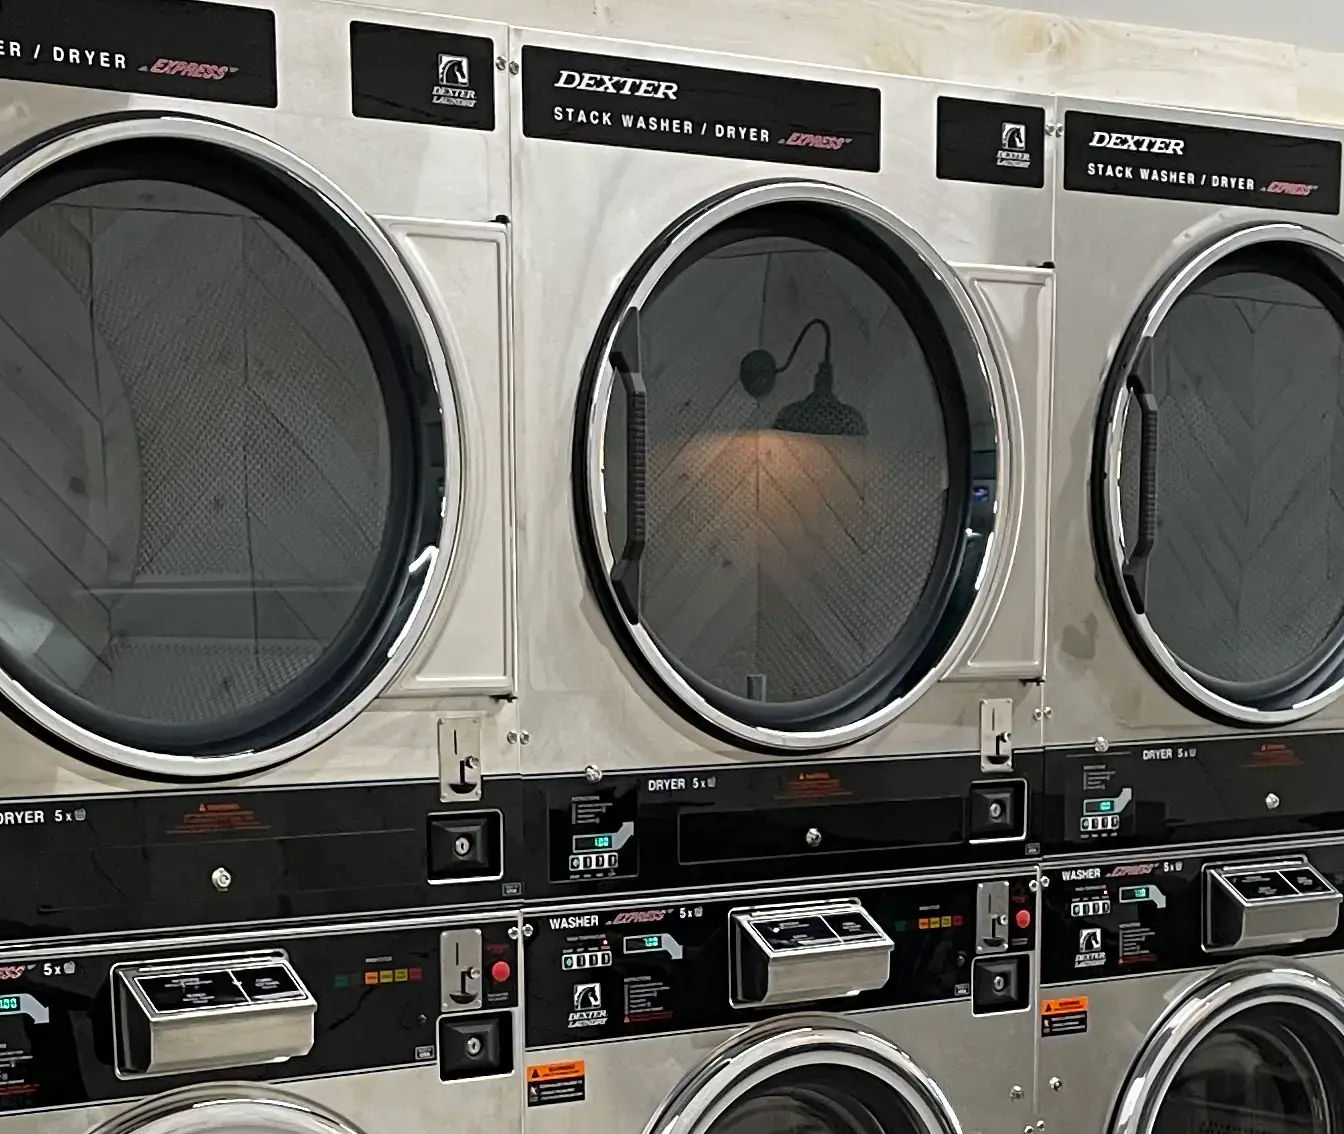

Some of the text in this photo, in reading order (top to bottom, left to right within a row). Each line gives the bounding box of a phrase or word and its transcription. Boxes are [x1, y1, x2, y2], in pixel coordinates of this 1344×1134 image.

[34, 44, 41, 58] /
[53, 46, 126, 68] DRYER
[149, 58, 228, 80] EXPRESS
[432, 86, 476, 99] DEXTER
[554, 70, 678, 100] DEXTER
[554, 107, 612, 126] STACK
[622, 114, 693, 134] WASHER
[700, 123, 706, 136] /
[716, 124, 770, 142] DRYER
[1089, 131, 1185, 156] DEXTER
[1088, 163, 1132, 178] STACK
[1140, 168, 1194, 185] WASHER
[1212, 175, 1254, 190] DRYER
[648, 778, 686, 792] DRYER
[692, 778, 700, 788] 5
[54, 810, 62, 822] 5
[66, 813, 72, 822] x
[1062, 868, 1101, 881] WASHER
[550, 915, 599, 930] WASHER
[680, 908, 686, 919] 5
[44, 963, 52, 976] 5
[54, 966, 61, 975] x
[568, 1010, 606, 1021] DEXTER
